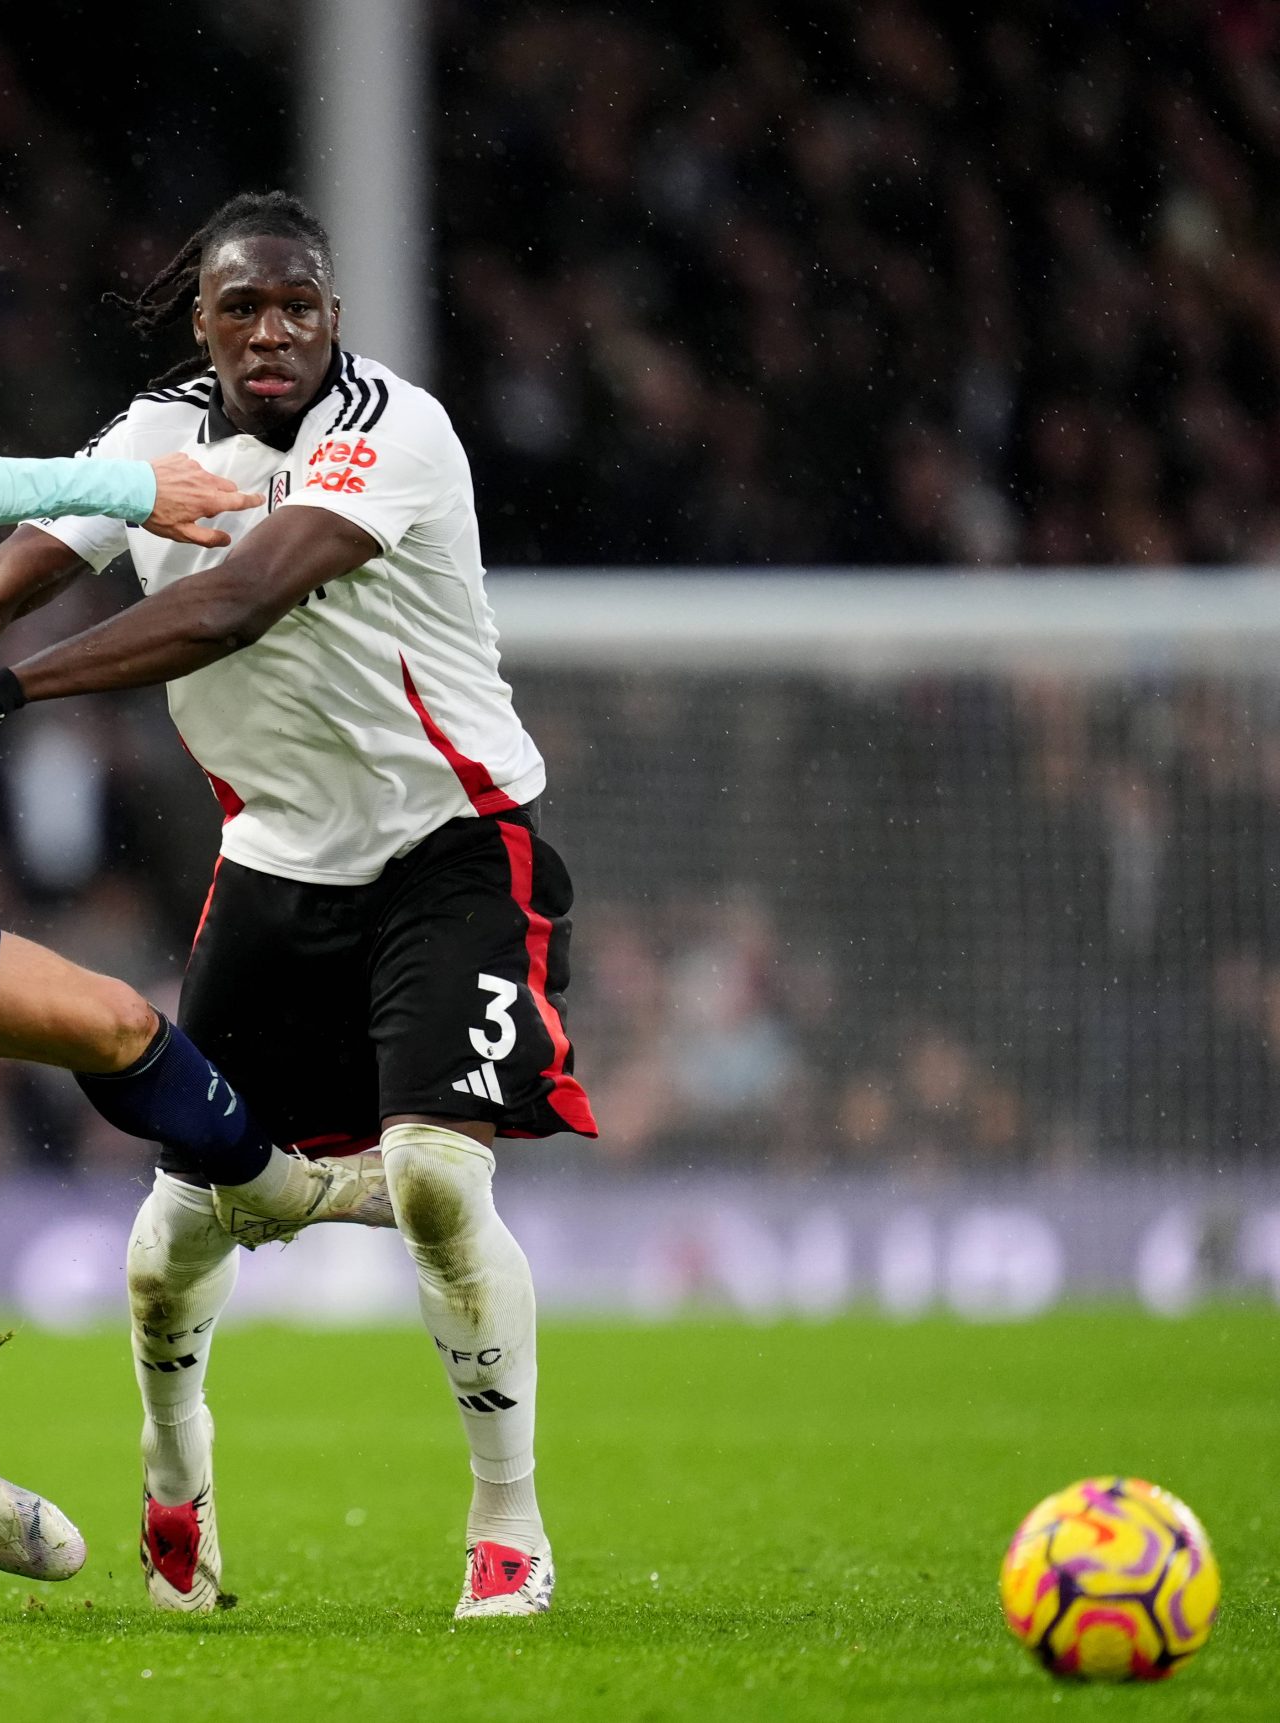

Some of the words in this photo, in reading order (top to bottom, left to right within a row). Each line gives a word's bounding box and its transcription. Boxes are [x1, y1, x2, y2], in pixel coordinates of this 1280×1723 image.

[468, 972, 518, 1061] 3
[143, 1317, 214, 1344] FFC
[434, 1336, 502, 1366] FFC
